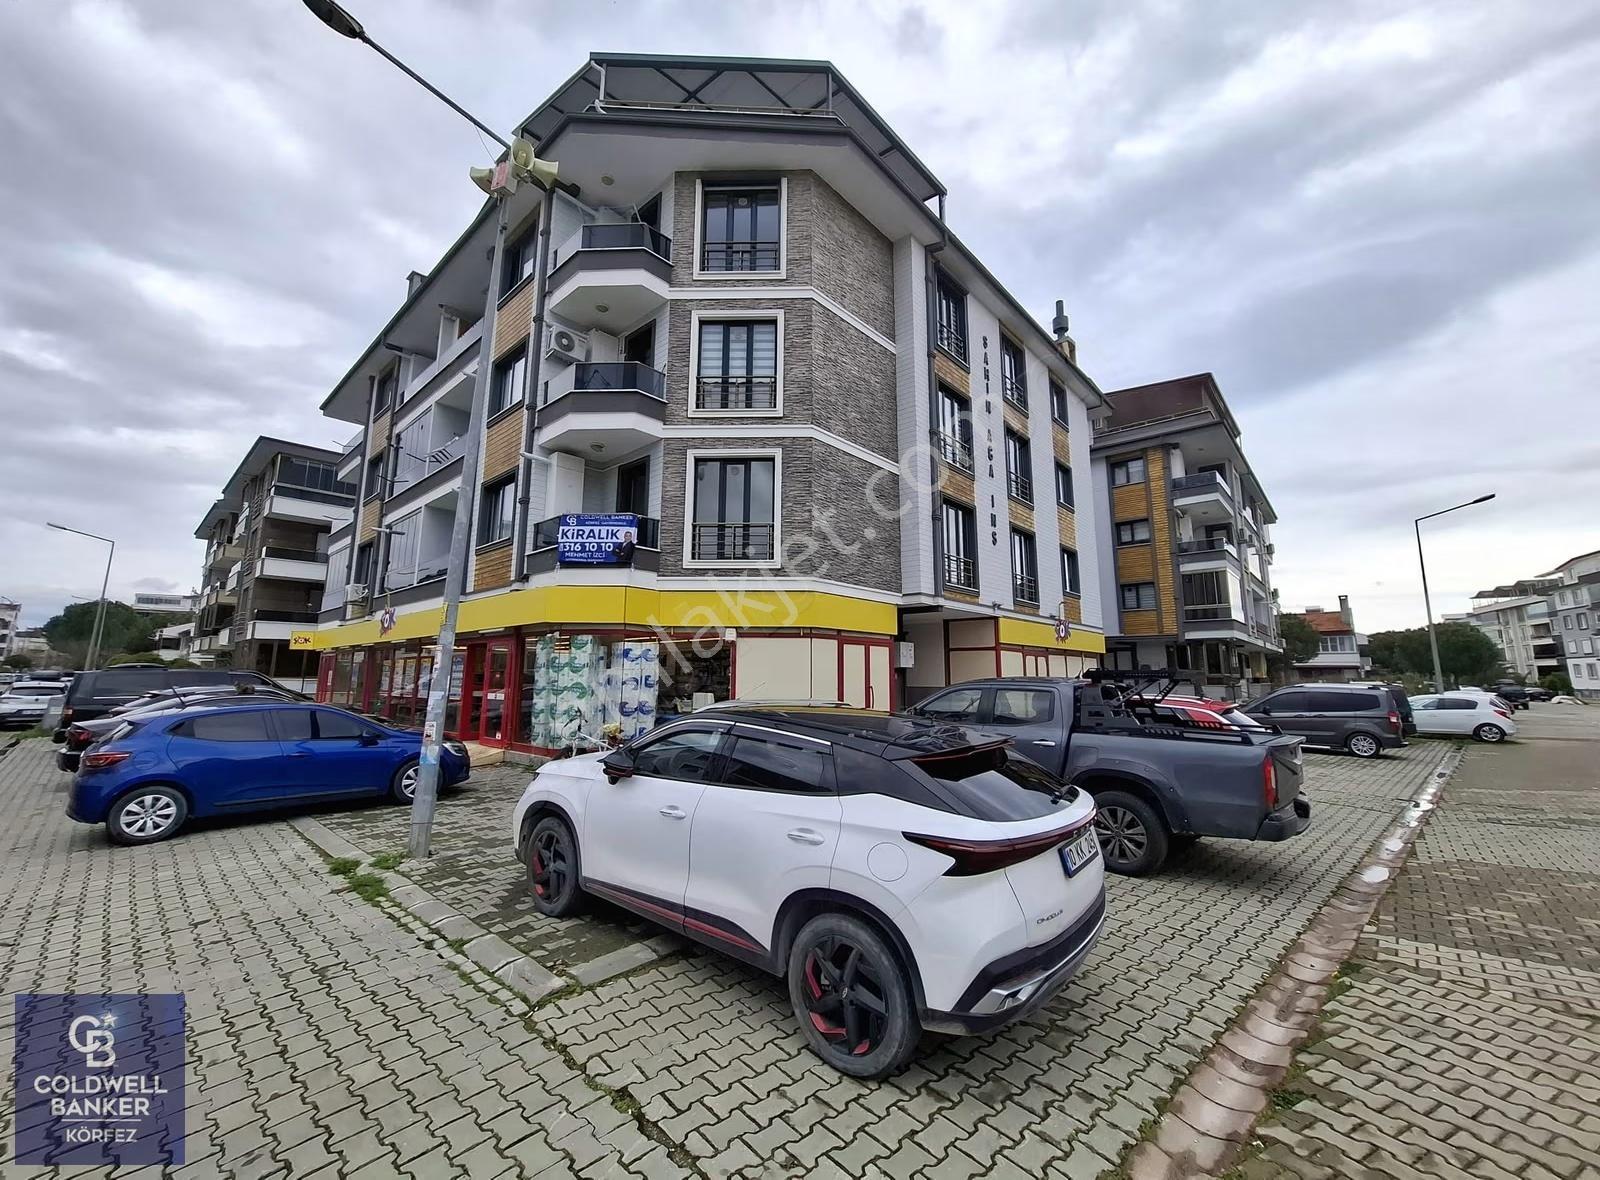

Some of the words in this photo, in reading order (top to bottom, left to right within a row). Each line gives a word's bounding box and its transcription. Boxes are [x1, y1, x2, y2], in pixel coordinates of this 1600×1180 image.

[563, 543, 581, 552] 316
[585, 543, 598, 552] 10
[601, 543, 613, 552] 10
